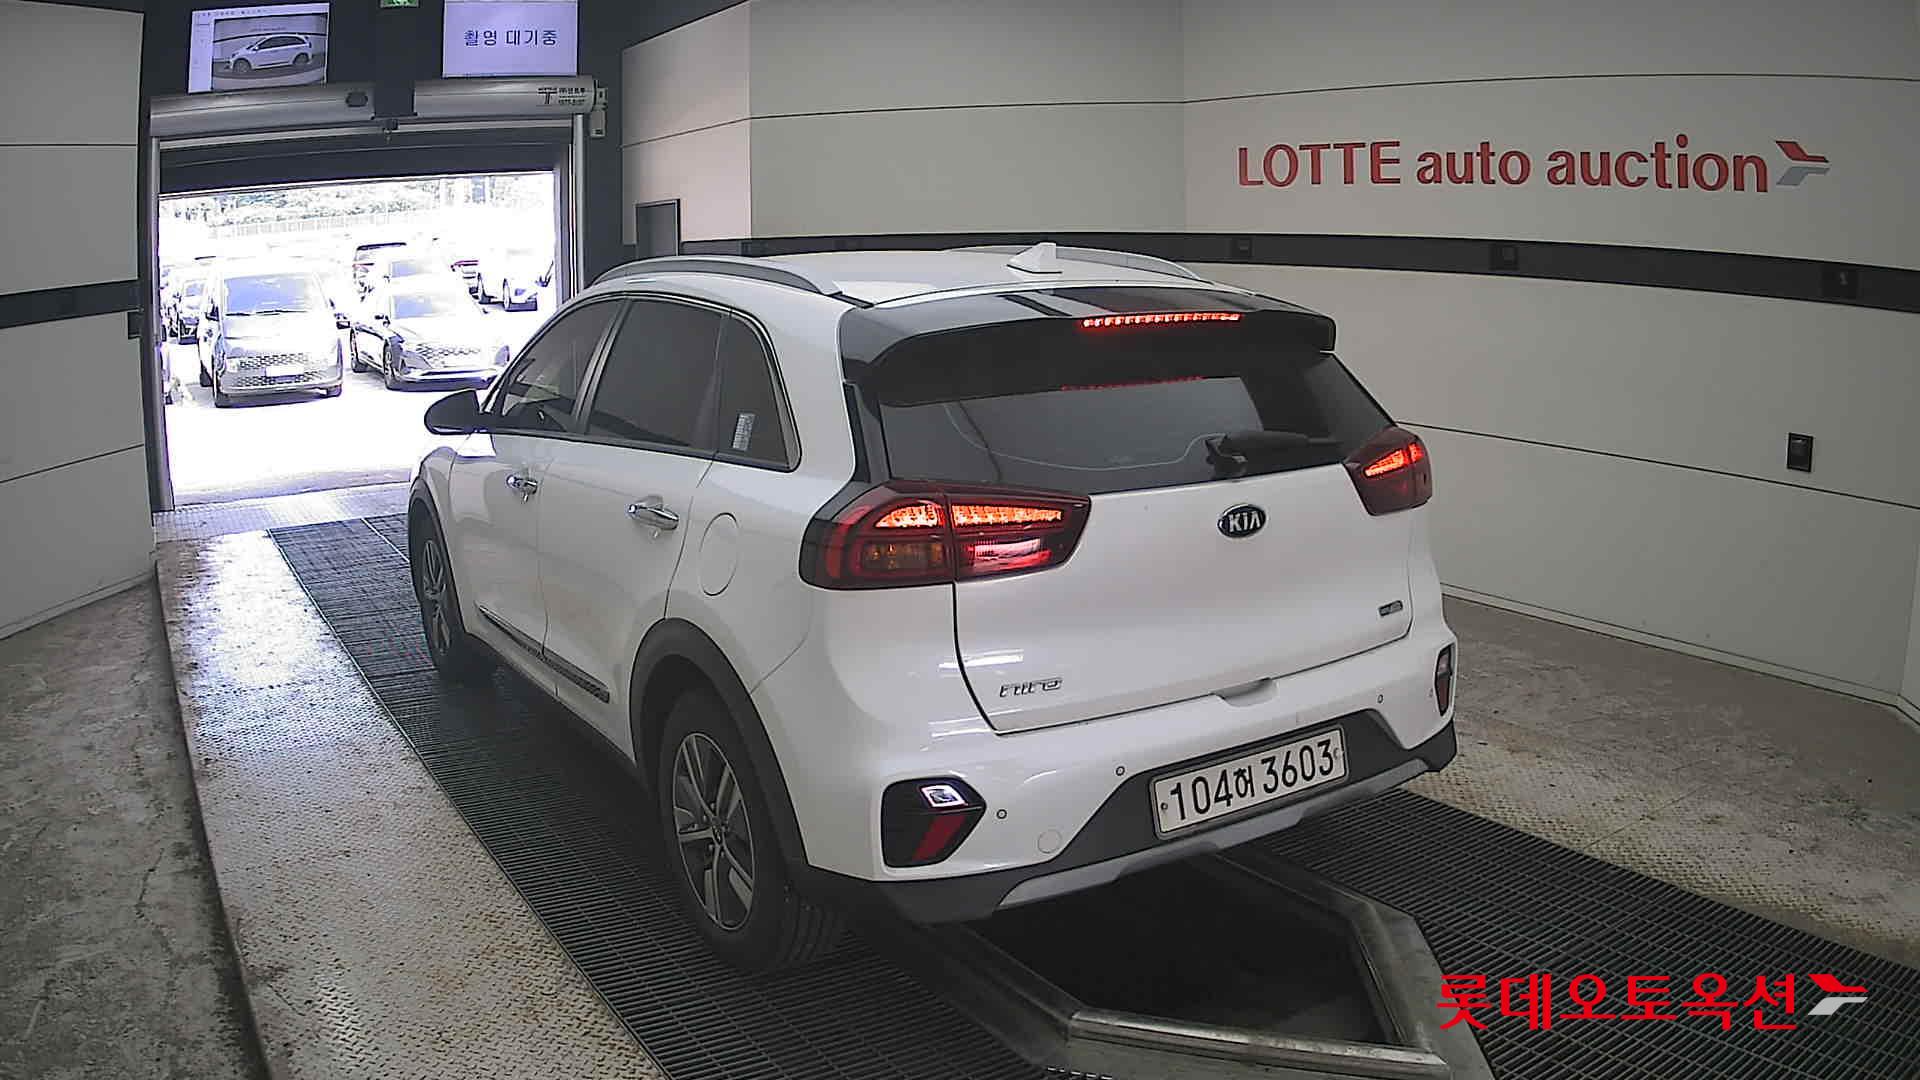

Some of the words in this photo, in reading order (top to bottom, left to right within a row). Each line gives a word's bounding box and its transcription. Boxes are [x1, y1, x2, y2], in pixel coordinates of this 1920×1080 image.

[505, 29, 558, 47] 대기중
[1238, 140, 1401, 187] LOTTE
[1416, 140, 1532, 186] auto
[1546, 134, 1769, 193] auction
[1229, 510, 1261, 532] KIA
[1260, 739, 1334, 793] 3603
